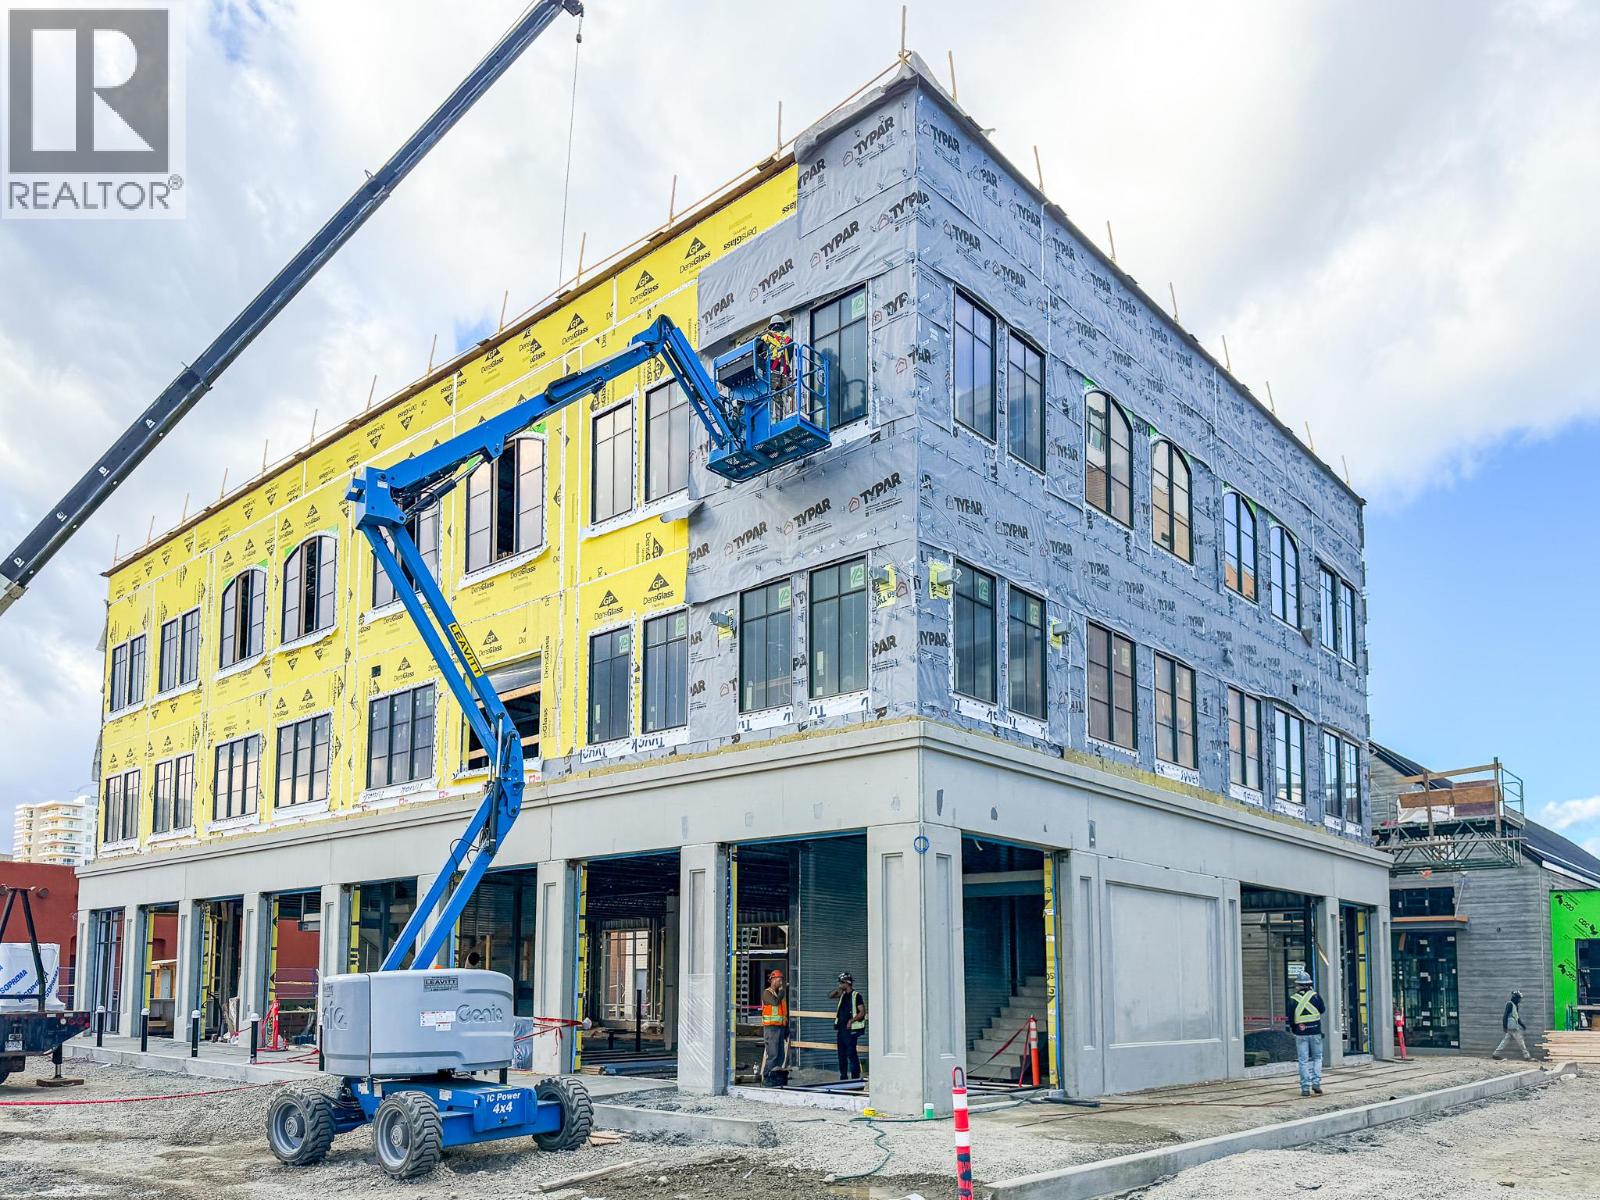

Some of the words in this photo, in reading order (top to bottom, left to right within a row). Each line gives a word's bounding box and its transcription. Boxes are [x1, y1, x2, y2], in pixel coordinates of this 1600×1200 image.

[854, 116, 895, 156] TYPAR
[931, 125, 961, 154] TYPAR
[1016, 202, 1042, 229] TYPAR
[723, 227, 757, 250] DensGlass
[820, 221, 860, 258] TYPAR
[952, 224, 982, 252] TYPAR
[1052, 234, 1075, 261] TYPAR
[690, 243, 701, 254] GP
[679, 250, 711, 274] DensGlass
[639, 275, 650, 286] GP
[758, 258, 794, 294] TYPAR
[1000, 264, 1027, 289] TYPAR
[1090, 272, 1112, 295] TYPAR
[629, 283, 659, 305] DensGlass
[702, 292, 735, 324] TYPAR
[1117, 297, 1138, 317] TYPAR
[570, 320, 581, 330] GP
[1075, 320, 1098, 341] TYPAR
[561, 326, 589, 346] DensGlass
[481, 355, 505, 374] DensGlass
[1112, 350, 1133, 369] TYPAR
[859, 472, 902, 504] TYPAR
[793, 497, 832, 528] TYPAR
[953, 496, 983, 515] TYPAR
[733, 521, 768, 549] TYPAR
[1003, 522, 1029, 539] TYPAR
[1050, 540, 1073, 556] TYPAR
[510, 565, 536, 579] DensGlass
[1088, 561, 1110, 576] TYPAR
[470, 581, 495, 594] DensGlass
[652, 578, 664, 589] GP
[1125, 581, 1144, 595] TYPAR
[603, 595, 614, 605] GP
[643, 590, 675, 605] DensGlass
[383, 613, 404, 625] DensGlass
[594, 605, 624, 620] DensGlass
[450, 623, 482, 676] LEAVITT
[478, 644, 503, 657] DensGlass
[394, 671, 415, 682] DensGlass
[0, 969, 28, 994] SOPREMA
[456, 1004, 503, 1024] Genie
[486, 1093, 496, 1102] IC
[497, 1091, 521, 1102] Power
[493, 1102, 513, 1114] 4x4
